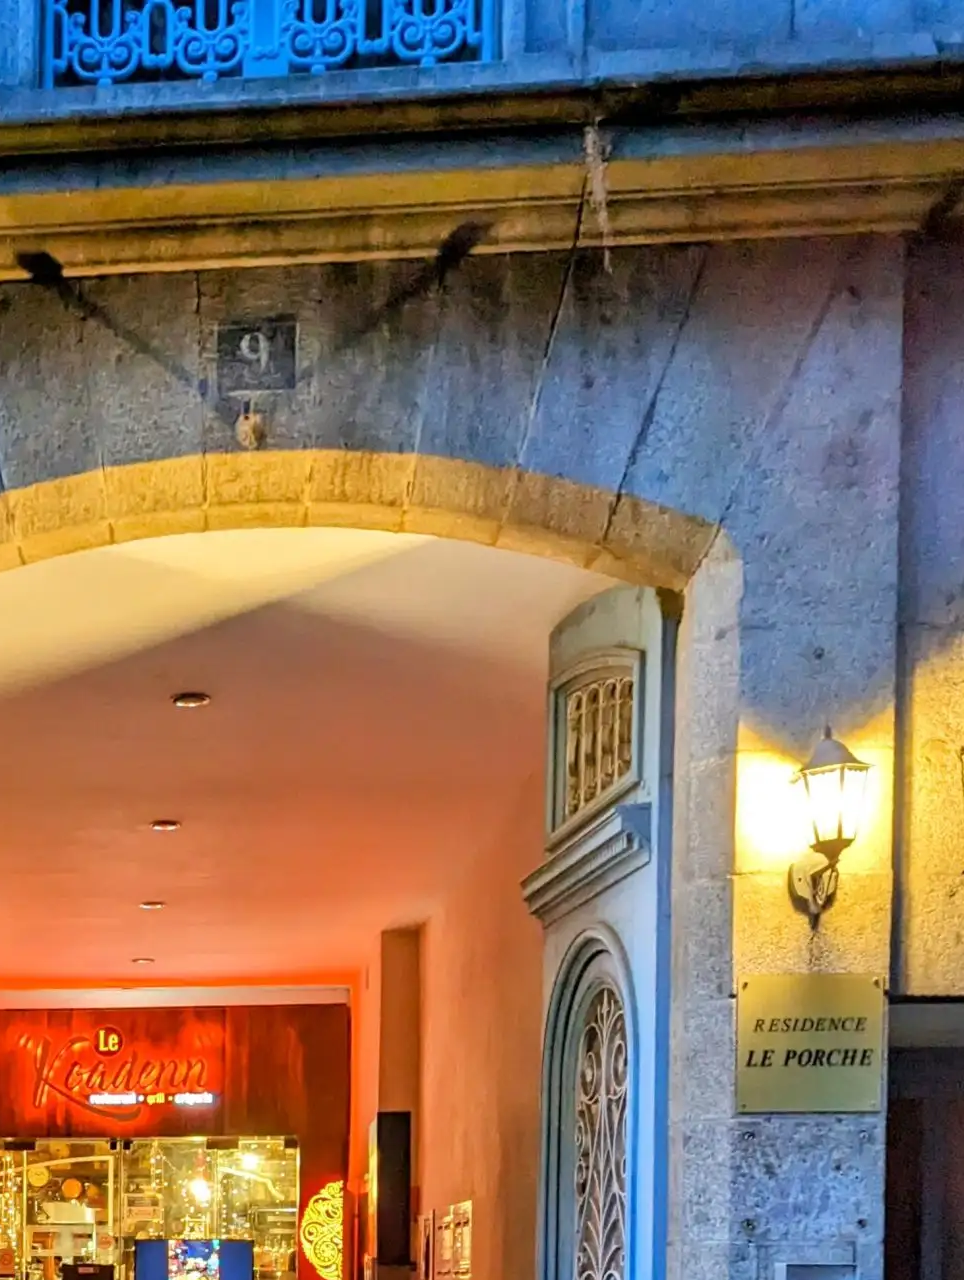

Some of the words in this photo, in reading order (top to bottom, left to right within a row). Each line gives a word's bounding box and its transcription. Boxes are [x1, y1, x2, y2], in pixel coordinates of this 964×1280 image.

[240, 332, 269, 378] 9
[753, 1016, 868, 1033] RESIDENCE
[99, 1030, 119, 1051] Le
[745, 1049, 775, 1067] LE
[782, 1048, 874, 1067] PORCHE
[33, 1036, 207, 1120] Koadenn
